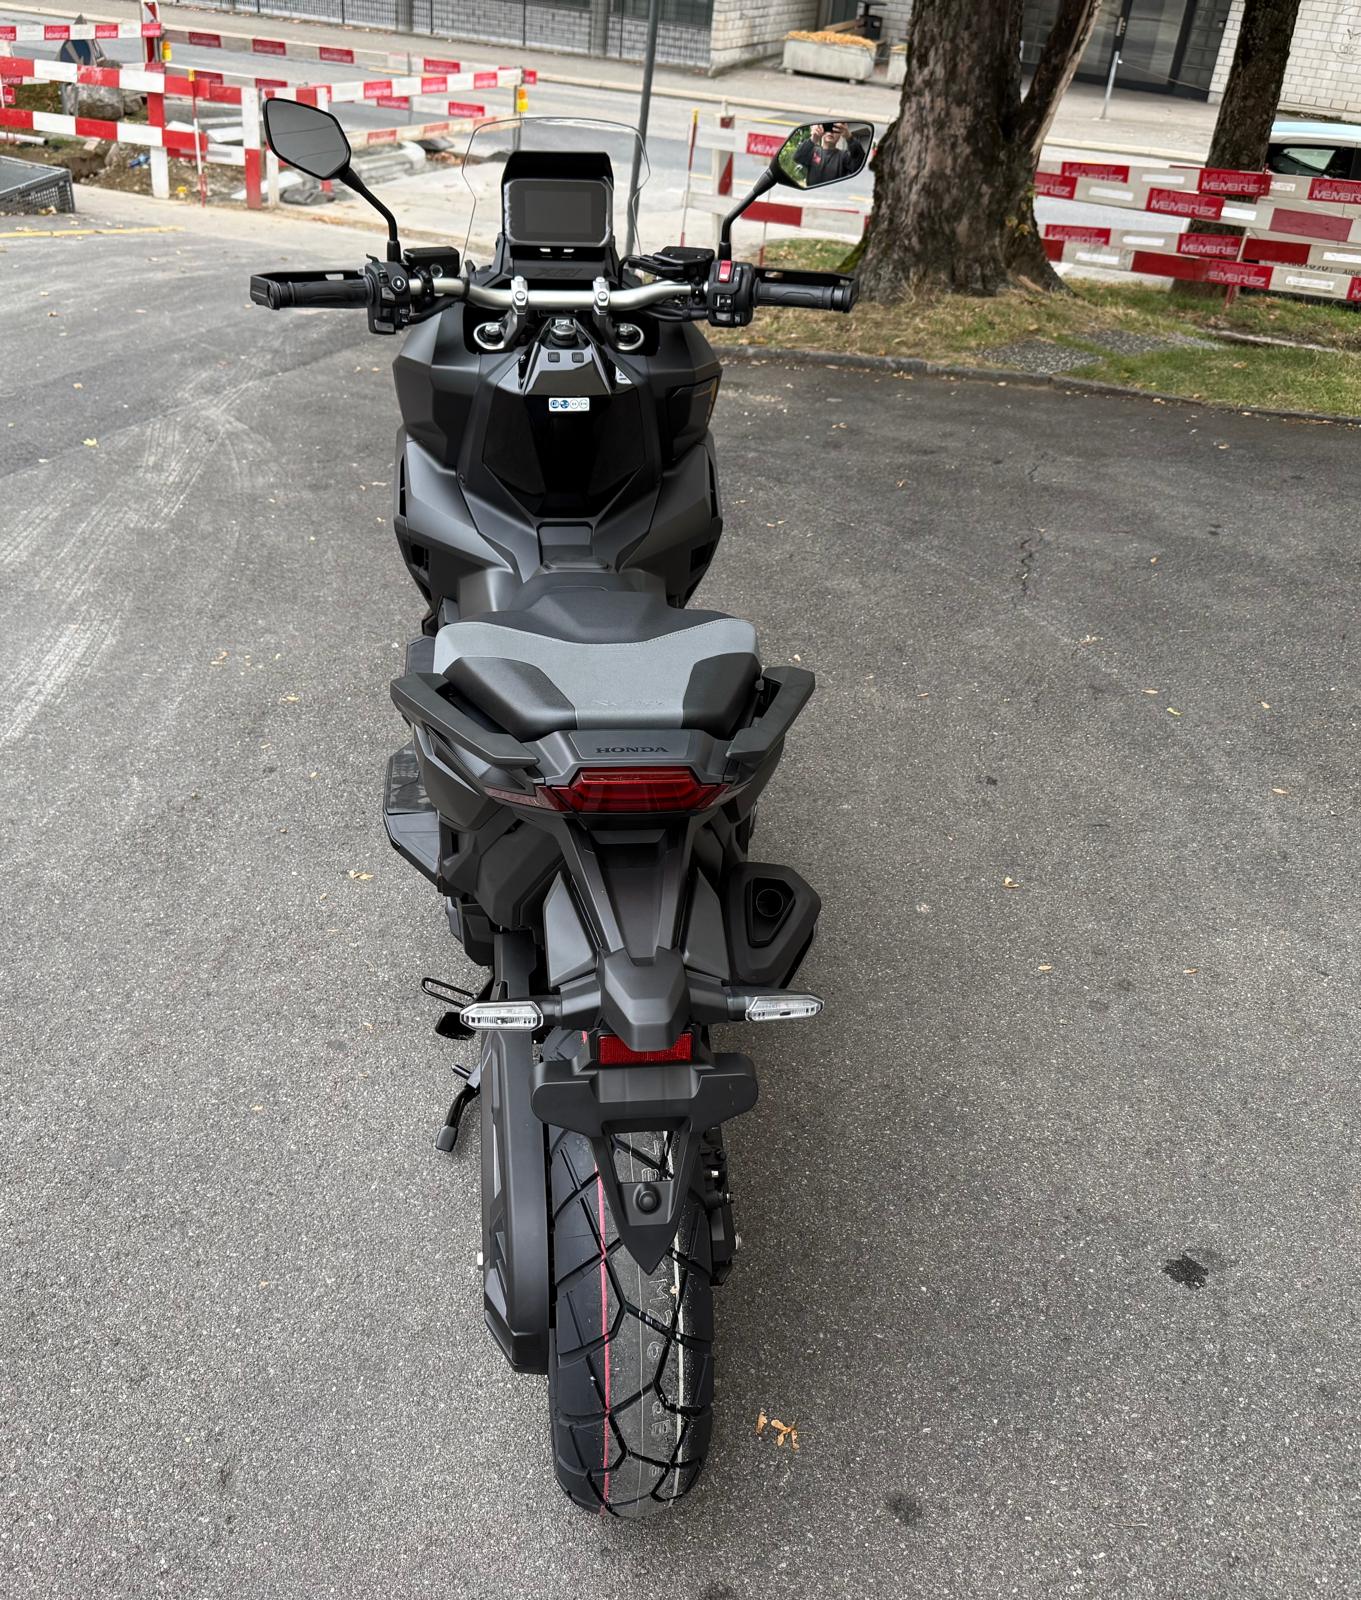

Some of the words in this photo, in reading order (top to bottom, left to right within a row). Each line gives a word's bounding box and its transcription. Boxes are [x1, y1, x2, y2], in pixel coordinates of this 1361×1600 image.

[1150, 199, 1217, 217] MEMBREZ
[1207, 270, 1266, 287] EMBREZ
[595, 746, 669, 754] HONDA
